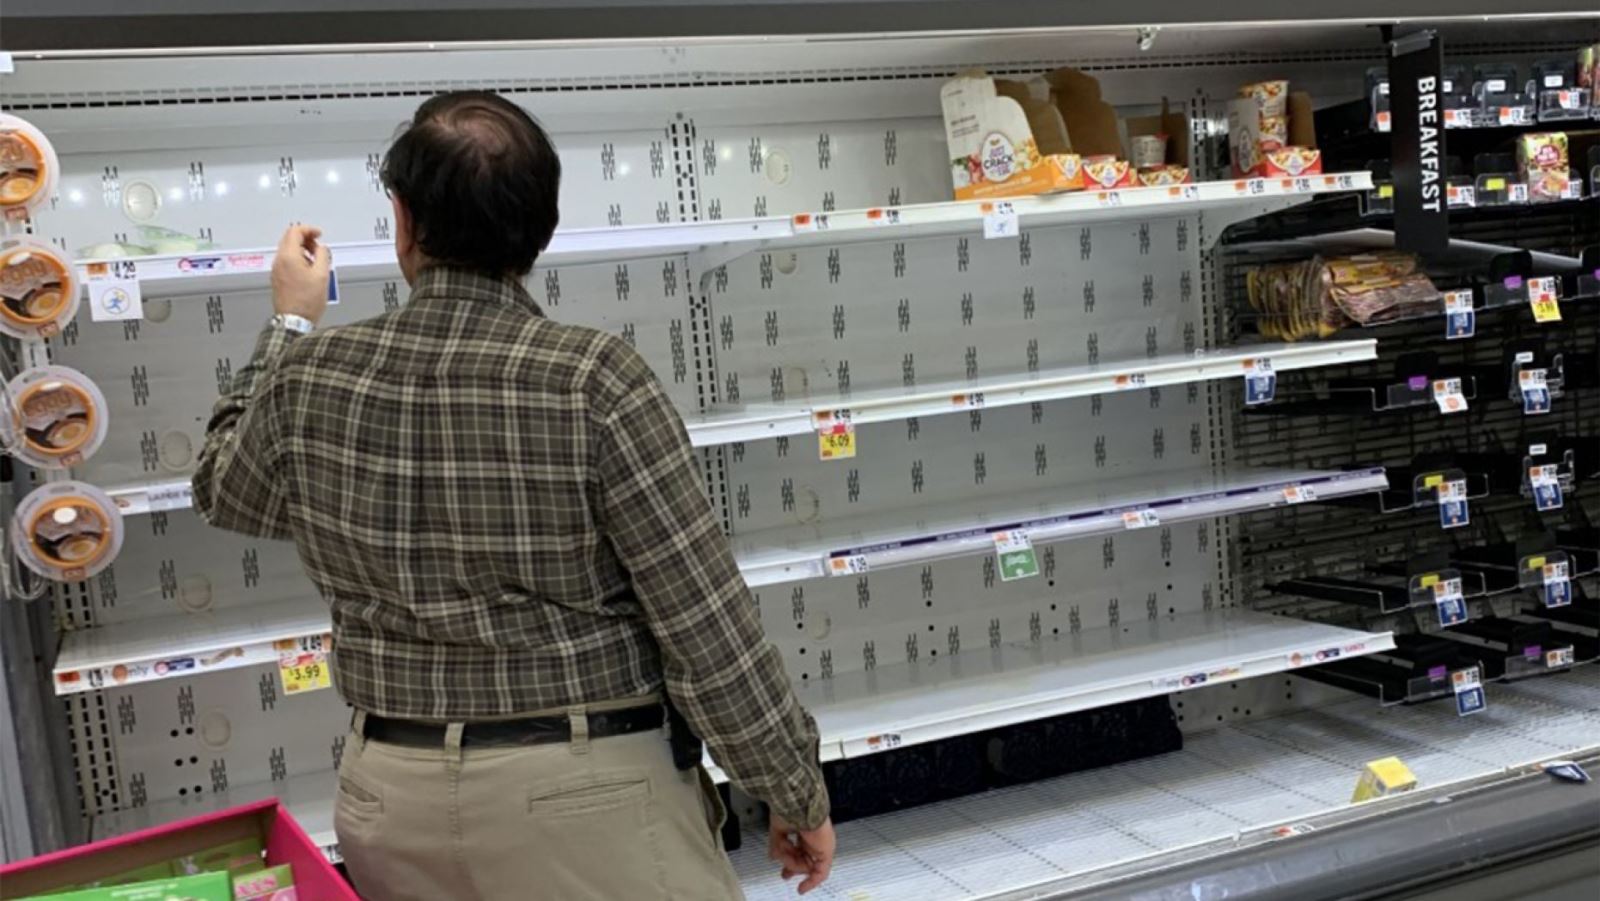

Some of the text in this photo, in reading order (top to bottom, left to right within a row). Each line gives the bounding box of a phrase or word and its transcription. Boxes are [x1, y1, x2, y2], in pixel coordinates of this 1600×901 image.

[1418, 76, 1440, 212] BREAKFAST
[984, 155, 1013, 169] CRACK
[289, 664, 321, 680] $3.99
